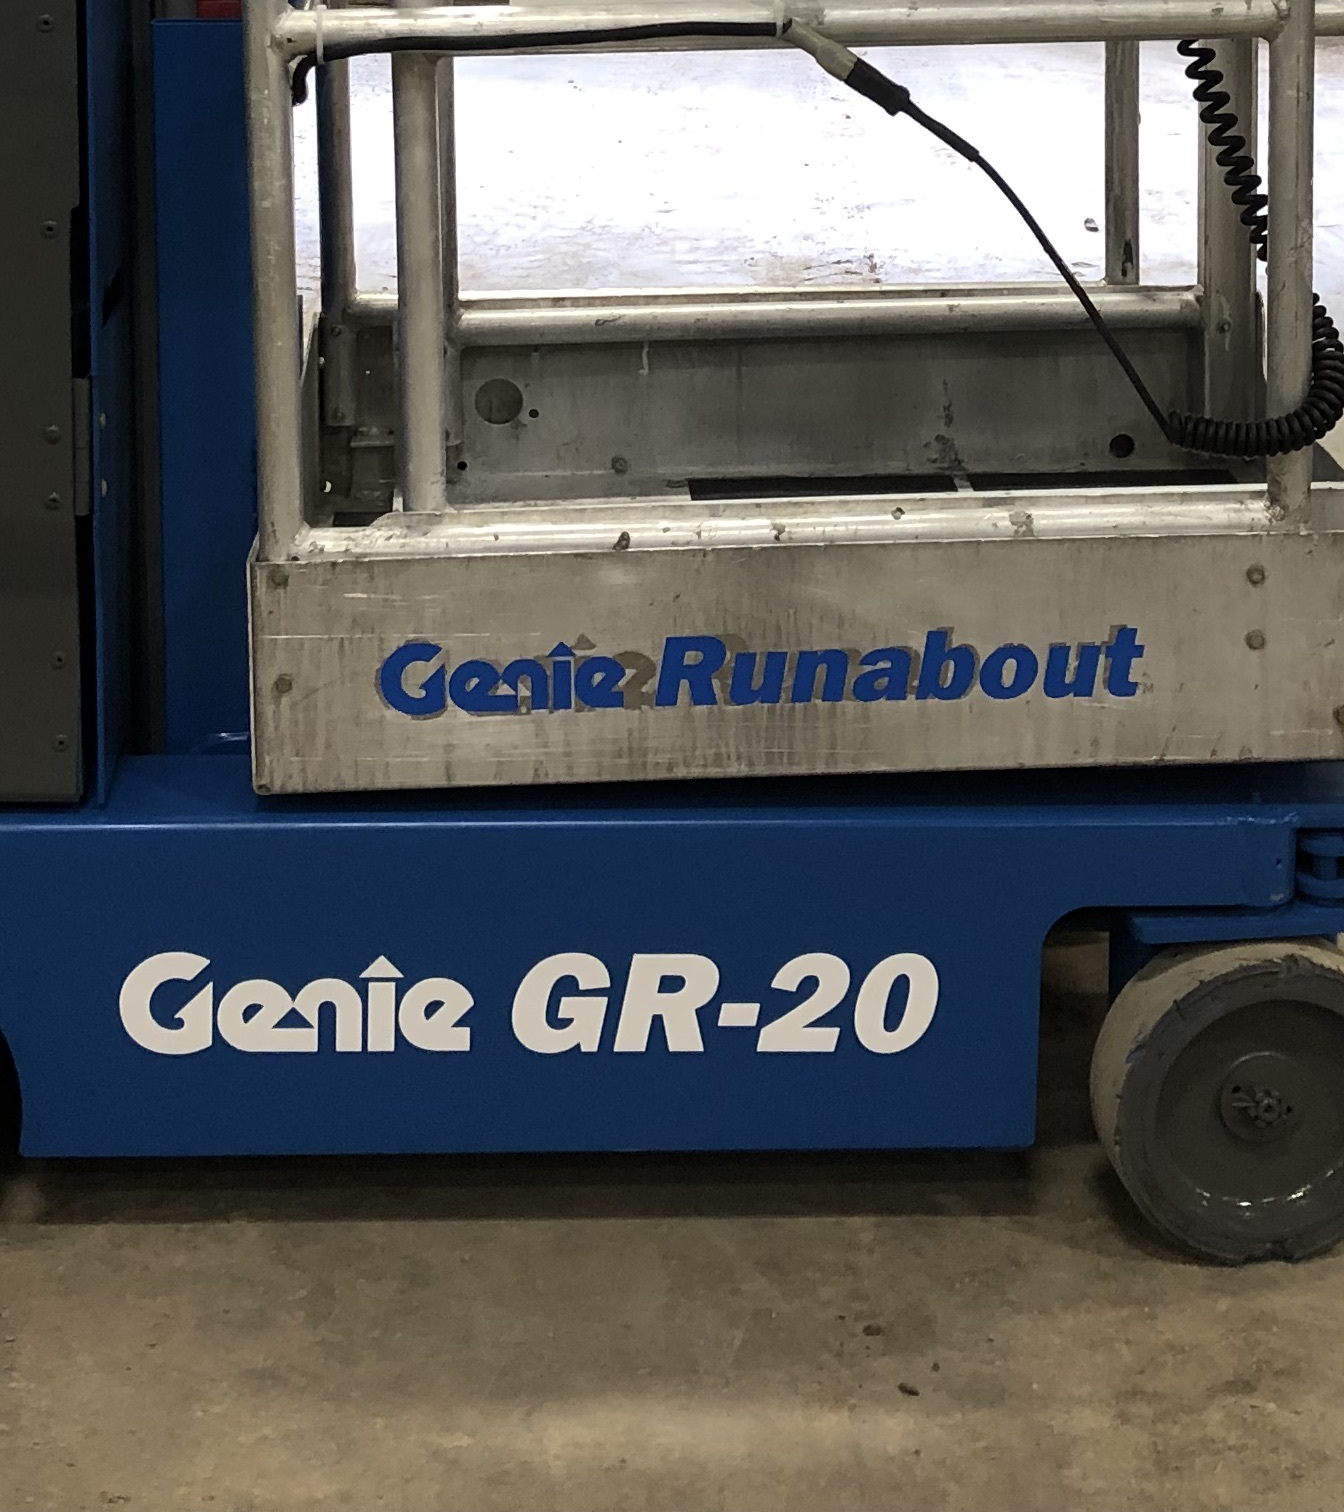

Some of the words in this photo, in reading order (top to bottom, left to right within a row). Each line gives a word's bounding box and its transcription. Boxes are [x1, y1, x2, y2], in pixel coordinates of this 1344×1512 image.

[381, 643, 625, 715] Genie
[657, 628, 1144, 706] Runabout
[119, 951, 475, 1055] Genie
[512, 952, 939, 1054] GR-20
